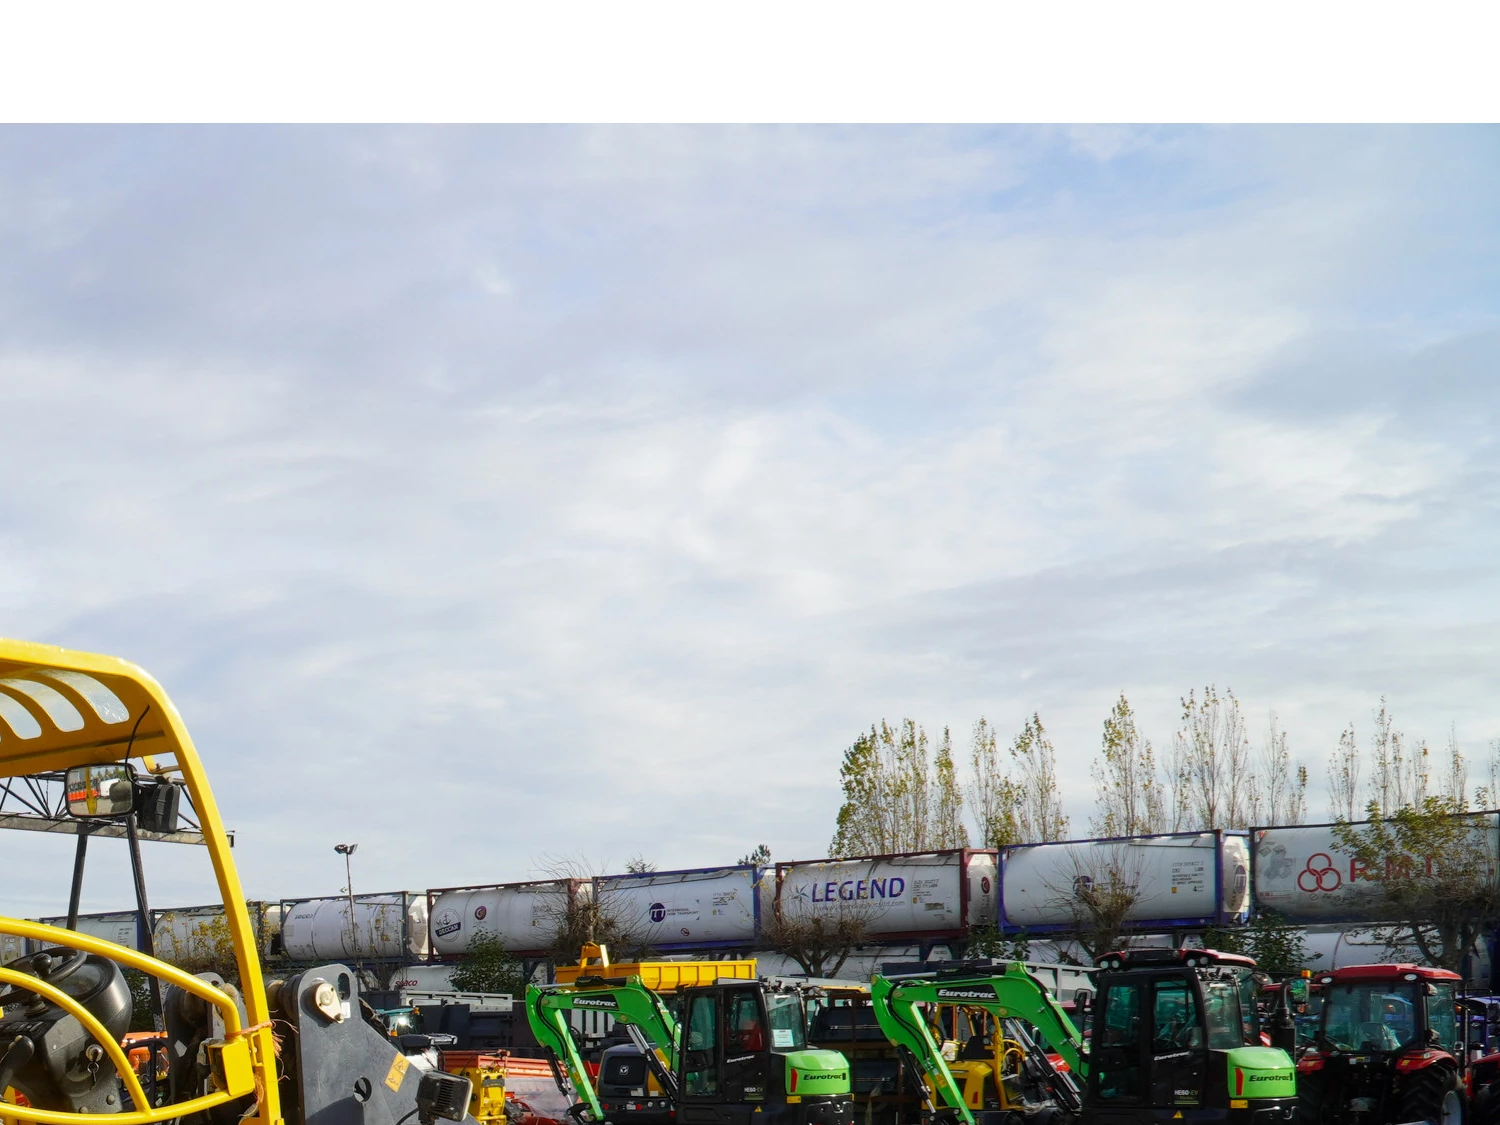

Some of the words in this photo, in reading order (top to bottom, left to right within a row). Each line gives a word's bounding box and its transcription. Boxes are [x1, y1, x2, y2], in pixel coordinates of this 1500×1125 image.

[812, 877, 905, 902] LEGEND
[438, 924, 459, 936] DECCAN
[938, 989, 996, 999] Eurotrac
[573, 997, 616, 1007] Eurotrac
[726, 1054, 755, 1063] Eurotrac
[1154, 1051, 1190, 1061] Eurotrac
[803, 1073, 842, 1081] Eurotrac
[1249, 1074, 1289, 1082] Eurotrac
